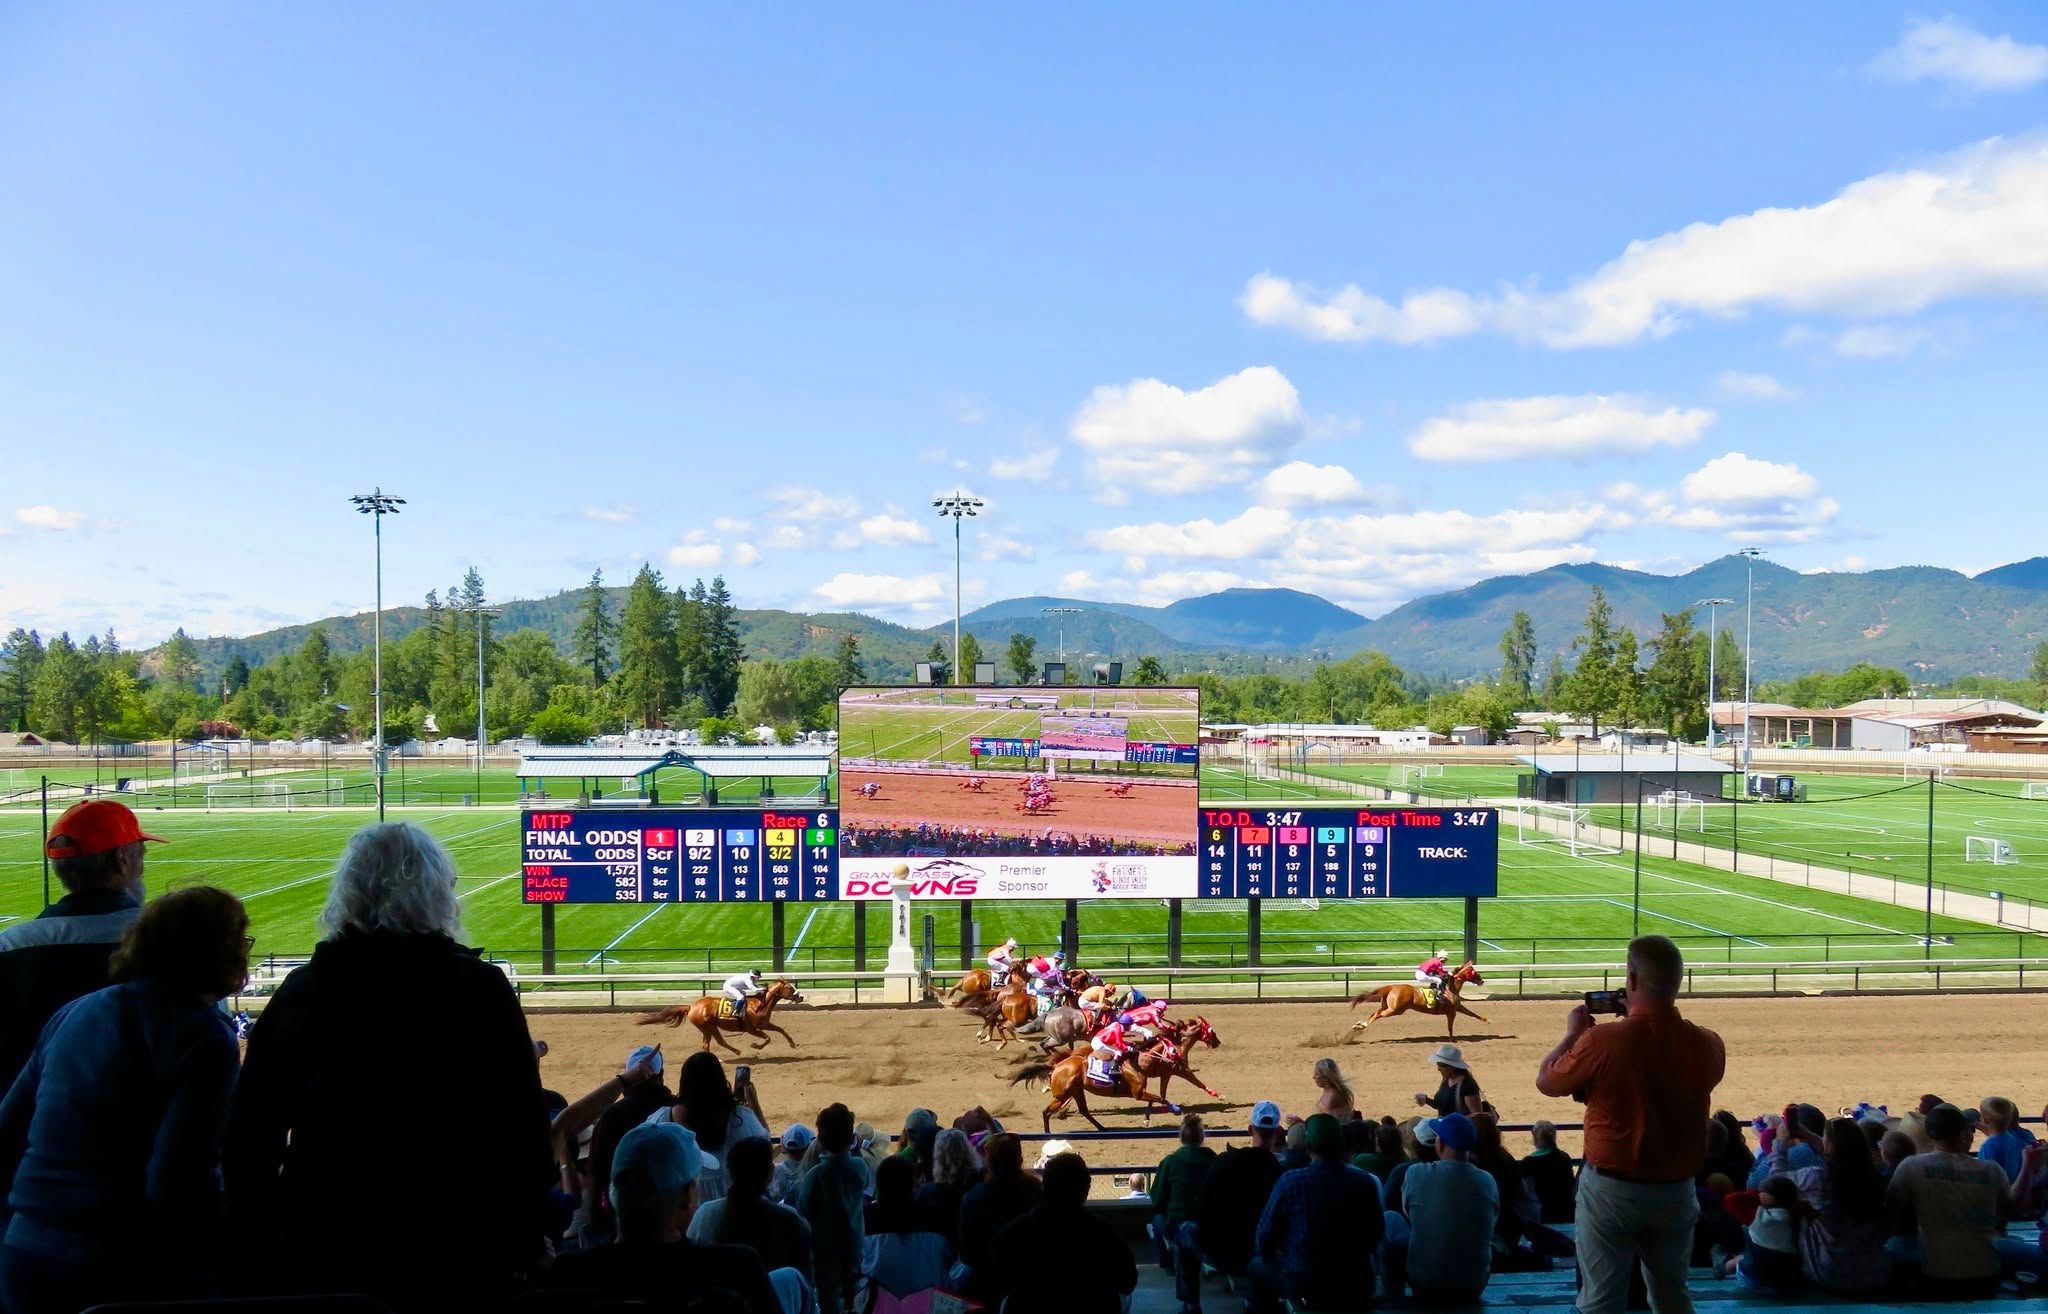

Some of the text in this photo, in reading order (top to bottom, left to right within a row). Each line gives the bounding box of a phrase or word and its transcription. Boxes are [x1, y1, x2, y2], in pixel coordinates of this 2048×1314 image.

[532, 815, 571, 828] MTP
[764, 813, 827, 827] Race 6
[1206, 812, 1301, 826] T.O.D. 3:47
[1359, 812, 1488, 826] Post Time 3:47
[527, 831, 637, 845] FINAL ODDS
[656, 832, 663, 843] 1
[696, 832, 703, 843] 2
[736, 832, 744, 843] 3
[776, 832, 784, 843] 4
[816, 832, 824, 843] 5
[1212, 830, 1221, 841] 6
[1252, 830, 1258, 841] 7
[1290, 830, 1297, 841] 8
[1327, 830, 1335, 841] 9
[1362, 830, 1377, 841] 10
[527, 849, 635, 860] TOTAL ODDS
[647, 848, 673, 860] Scr
[689, 848, 711, 860] 9/2
[732, 847, 749, 859] 10
[770, 847, 791, 859] 3/2
[813, 847, 827, 859] 11
[1209, 845, 1225, 857] 14
[1248, 845, 1261, 857] 11
[1289, 845, 1297, 856] 8
[1328, 845, 1335, 856] 5
[1365, 845, 1373, 856] 9
[1418, 848, 1467, 858] TRACK:
[526, 865, 636, 876] WIN 1,572
[653, 866, 668, 874] Scr
[813, 865, 828, 873] 104
[1000, 865, 1045, 876] Premier
[527, 878, 636, 888] PLACE 582
[653, 878, 668, 886] Scr
[1288, 874, 1297, 882] 51
[999, 880, 1048, 891] Sponsor
[1211, 887, 1220, 895] 31
[527, 890, 636, 901] SHOW 535
[653, 891, 668, 899] Scr
